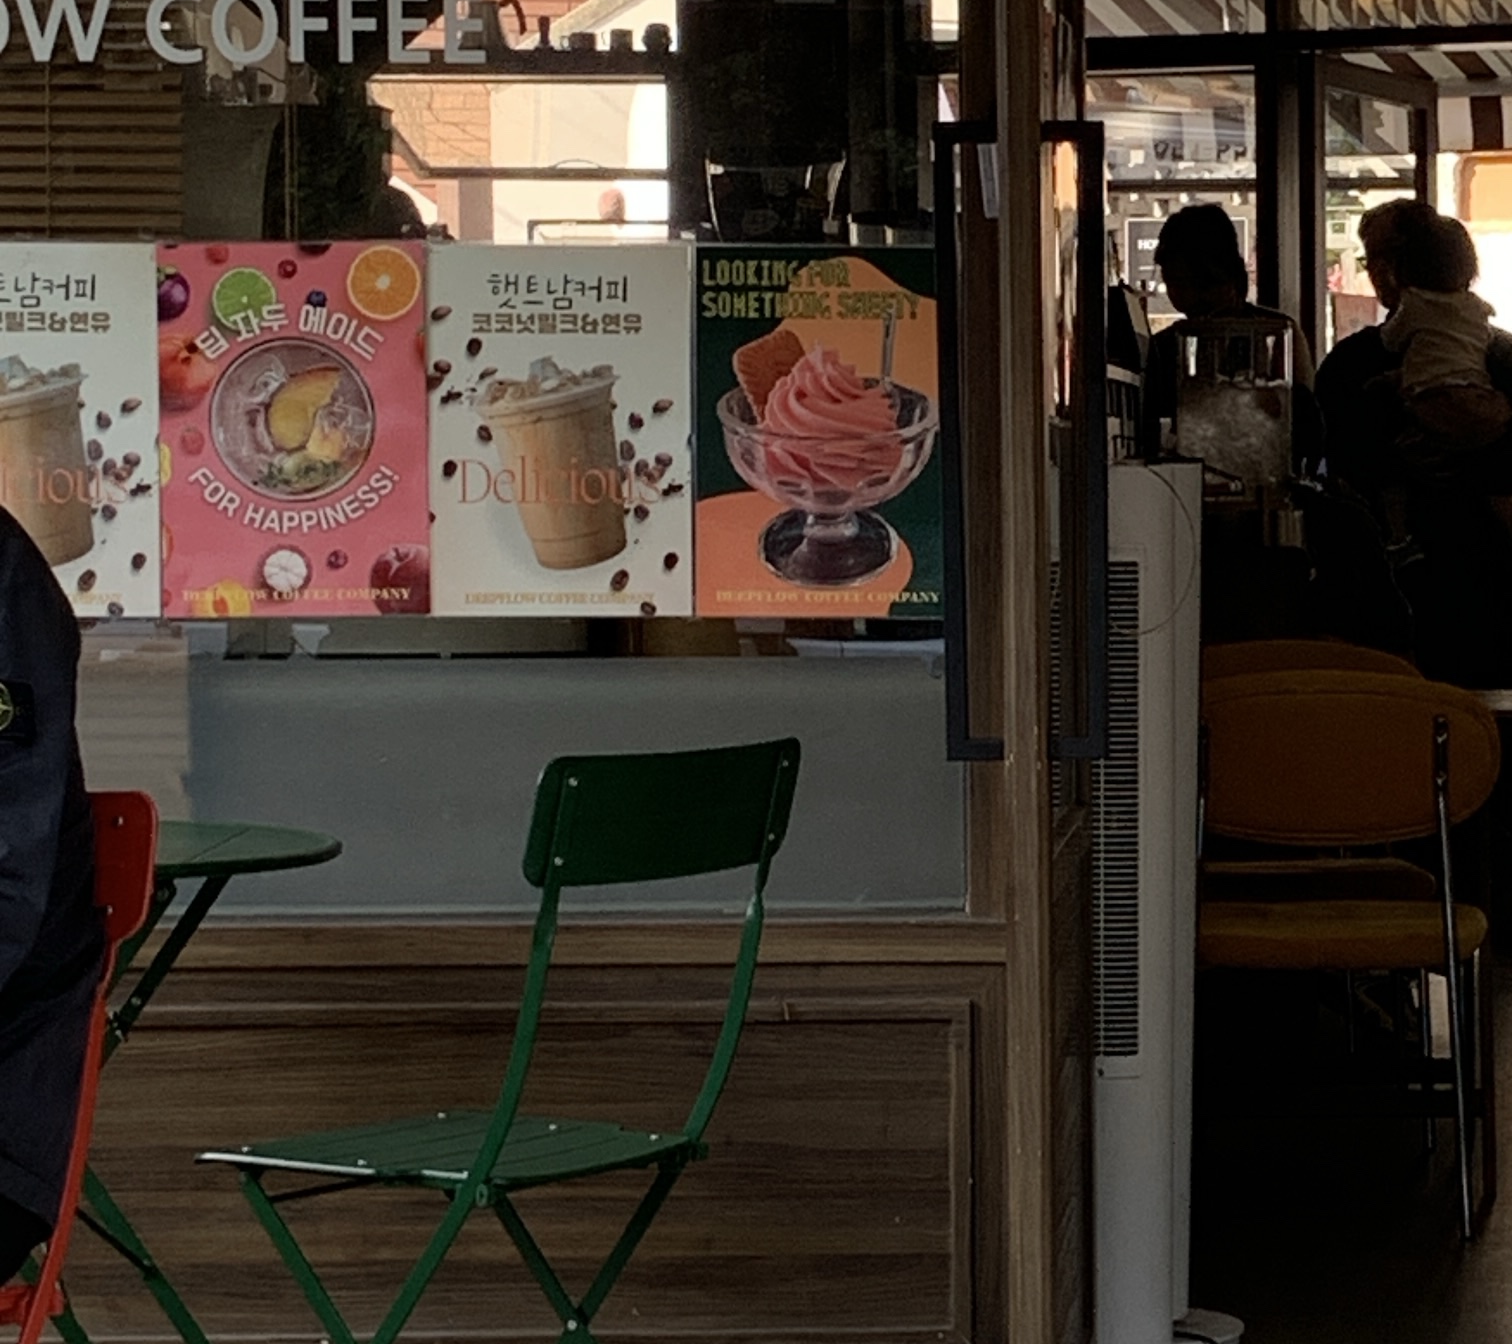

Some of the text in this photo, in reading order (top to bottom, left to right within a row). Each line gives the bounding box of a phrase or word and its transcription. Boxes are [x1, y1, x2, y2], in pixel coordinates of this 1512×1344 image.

[702, 259, 851, 288] LOOKING FOR
[487, 273, 629, 311] 햇트남커피
[702, 291, 832, 320] SOMETHING
[0, 311, 111, 334] 밀크&연유
[229, 304, 289, 343] 자두
[299, 305, 385, 361] 에이드
[472, 312, 642, 335] 코코넛밀크&연유
[188, 465, 400, 534] FOR HAPPINESS!
[336, 586, 411, 601] COMPANY
[867, 591, 941, 604] COMPANY
